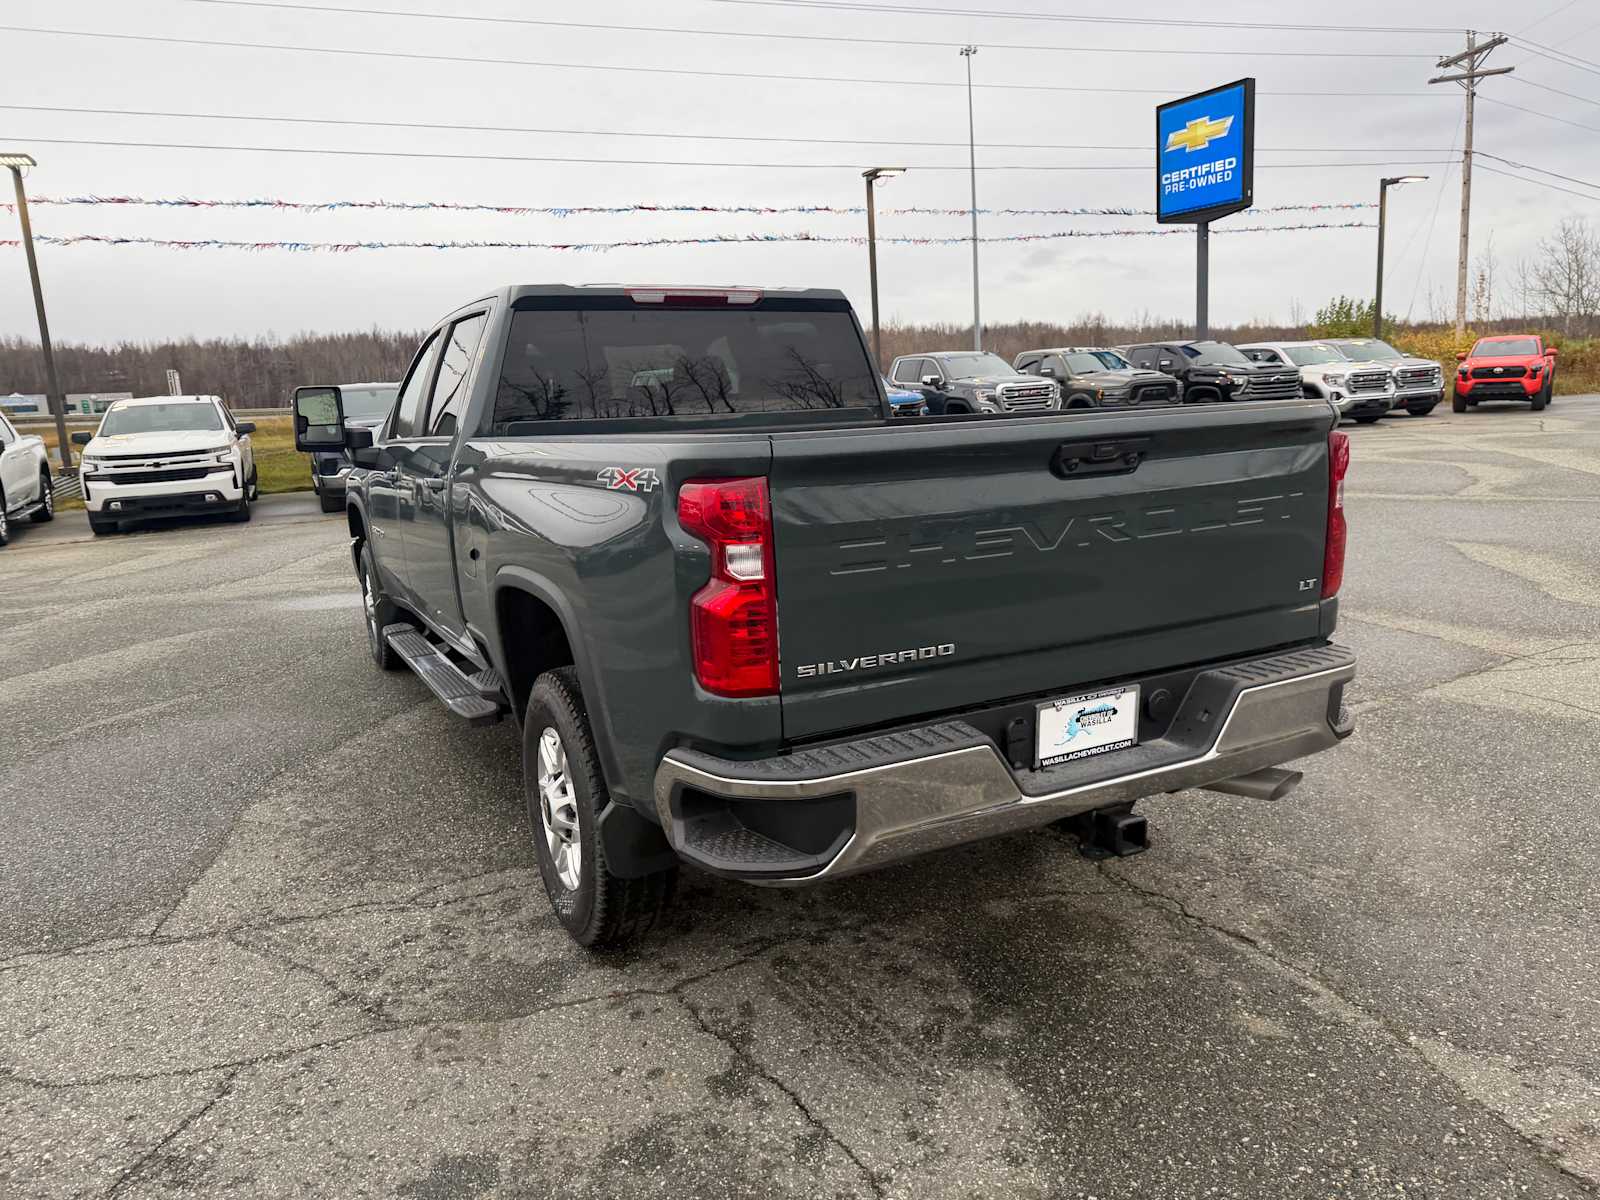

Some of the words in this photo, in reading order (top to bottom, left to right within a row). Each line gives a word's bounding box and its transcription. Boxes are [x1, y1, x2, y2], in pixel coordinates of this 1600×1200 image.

[1161, 157, 1237, 185] CERTIFIED
[1164, 170, 1233, 196] PRE-OWNED
[1299, 578, 1317, 591] LT
[797, 643, 956, 678] SILVERADO
[1054, 694, 1088, 706] WASILLA
[1081, 716, 1112, 728] WASILLA
[1041, 739, 1132, 767] WASILLACHEVROLET.COM
